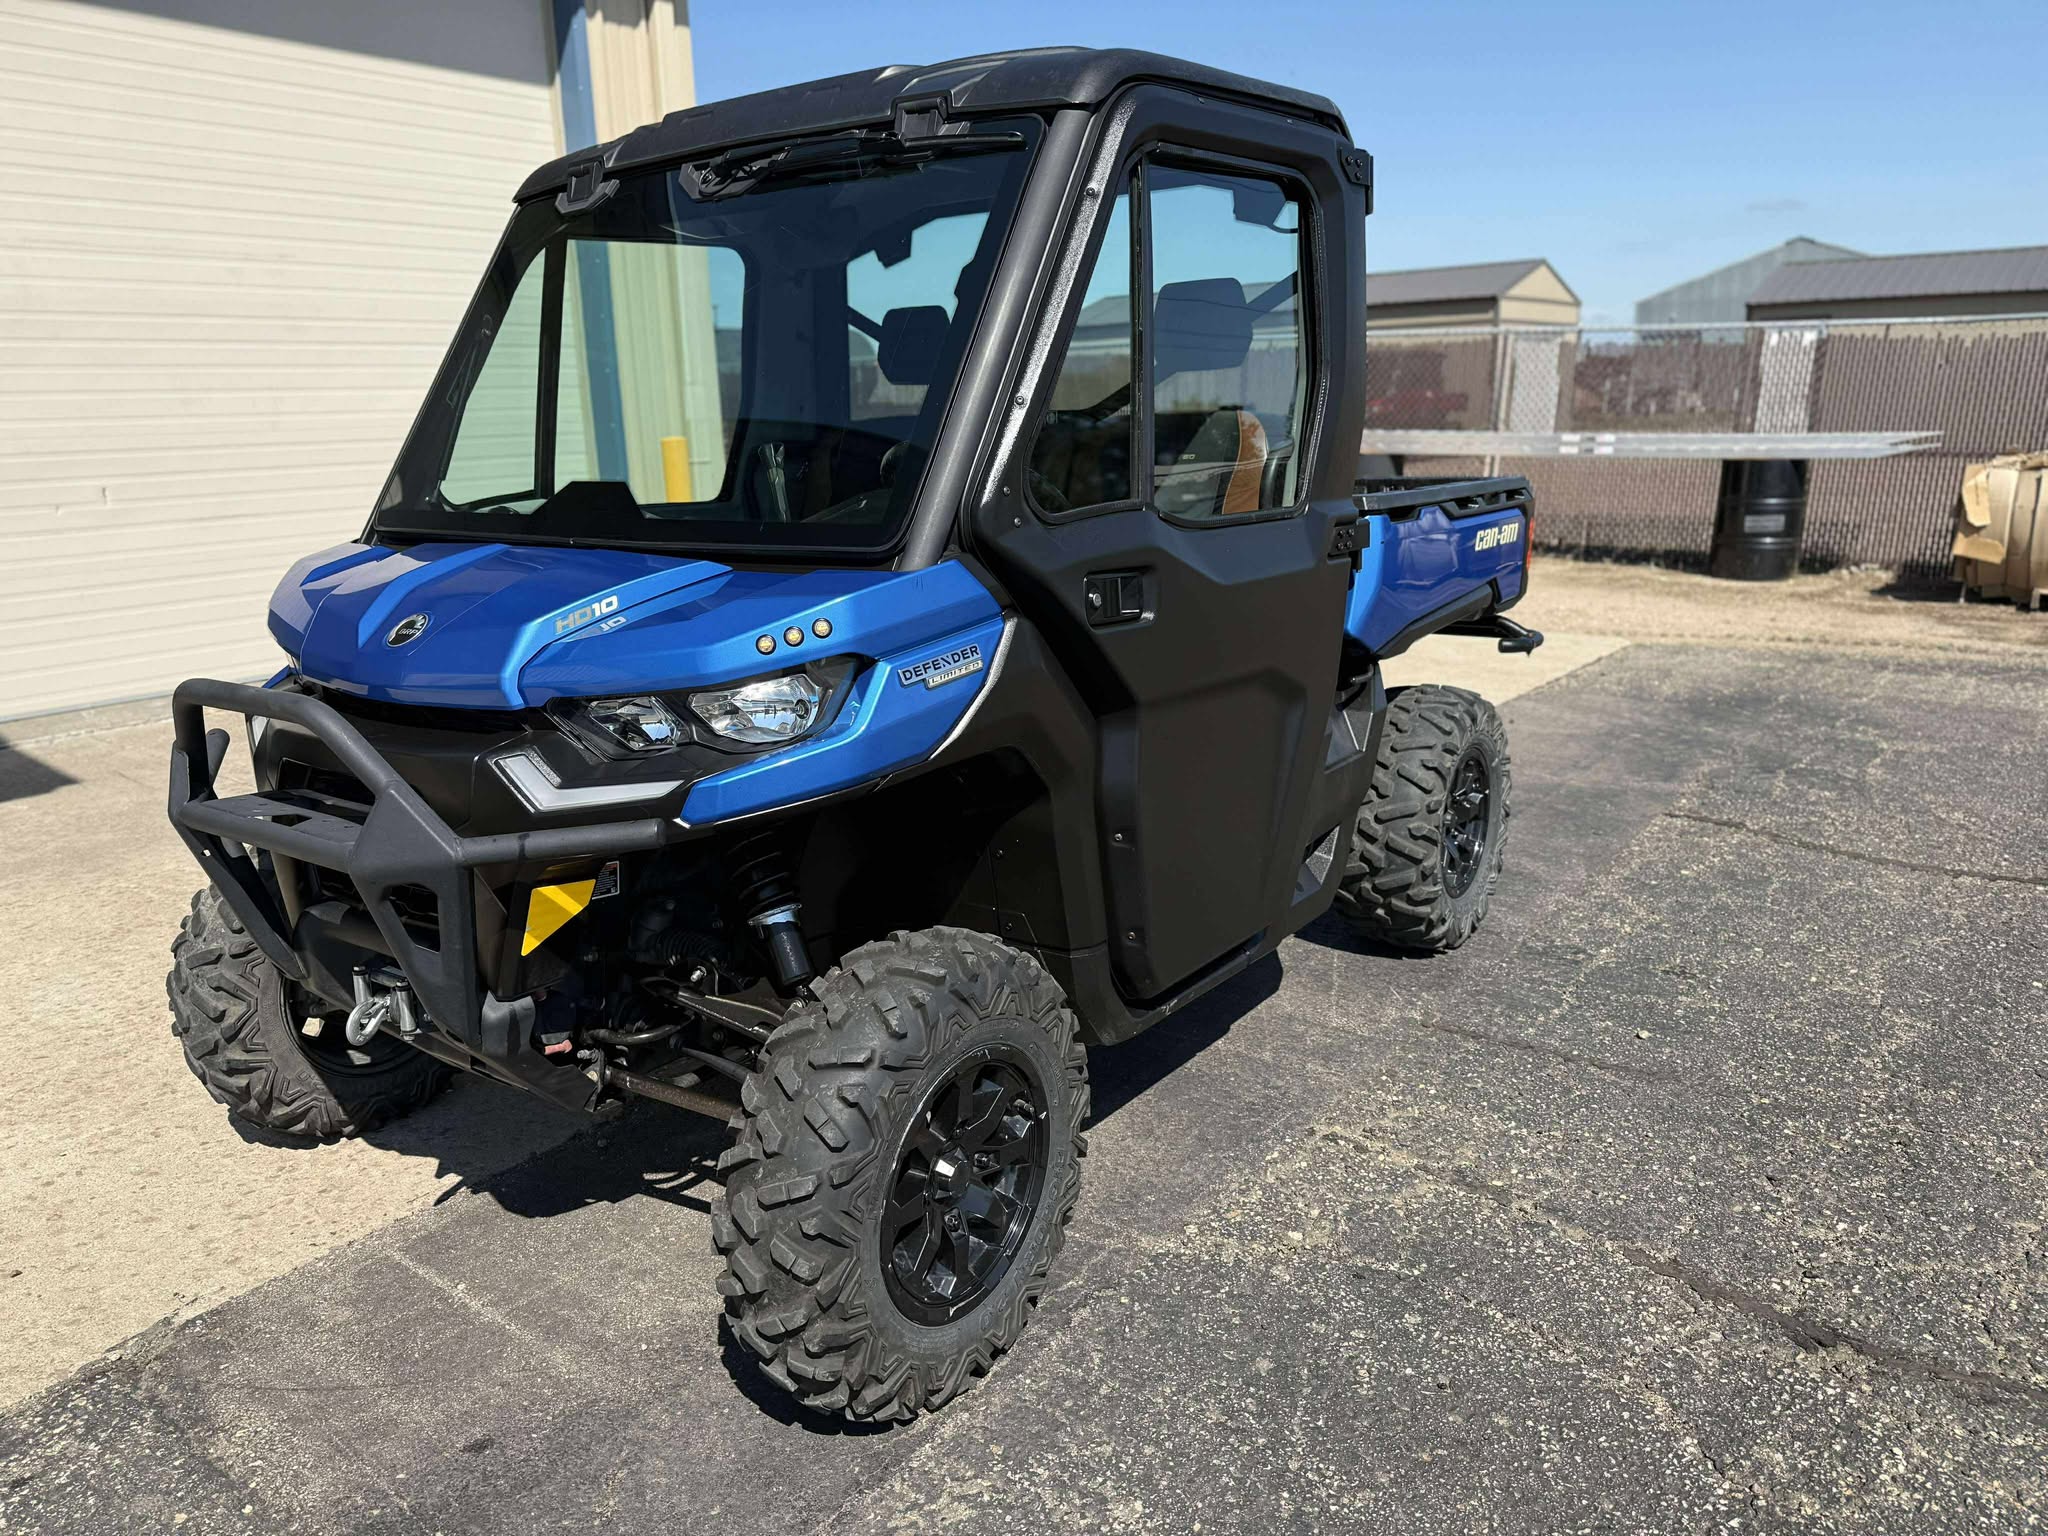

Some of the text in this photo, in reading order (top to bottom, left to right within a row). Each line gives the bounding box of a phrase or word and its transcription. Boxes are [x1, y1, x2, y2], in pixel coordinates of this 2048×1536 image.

[555, 594, 619, 634] HD10
[901, 645, 980, 682] DEFENDER
[930, 662, 980, 684] LIMITED
